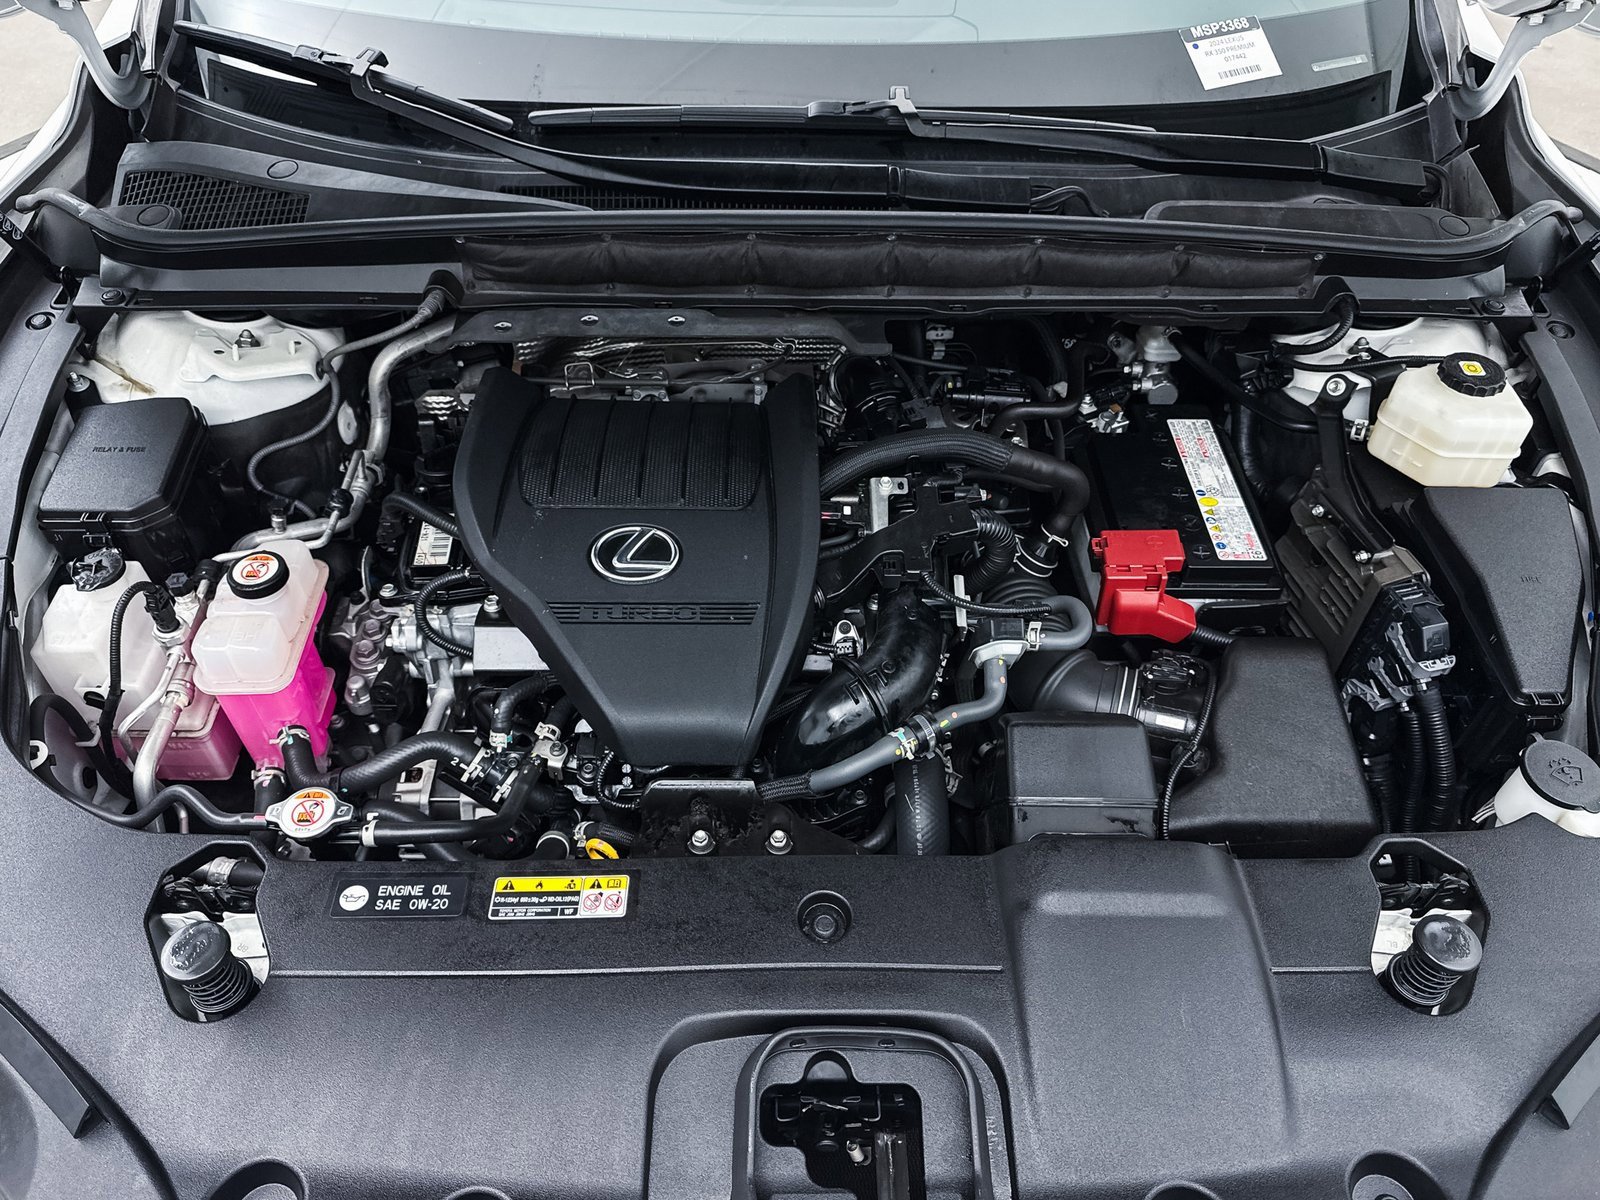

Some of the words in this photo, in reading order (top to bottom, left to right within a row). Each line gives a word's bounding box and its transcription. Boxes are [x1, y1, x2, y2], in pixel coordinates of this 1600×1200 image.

[1190, 17, 1250, 38] MSP3368
[1209, 39, 1224, 47] 2024
[1224, 35, 1245, 44] LEXUS
[1215, 47, 1226, 55] 350
[1226, 42, 1256, 52] PREMIUM
[581, 605, 699, 620] TURBO
[378, 885, 425, 896] ENGINE
[431, 884, 452, 896] OIL
[374, 899, 402, 910] SAE
[409, 898, 449, 910] 0W-20
